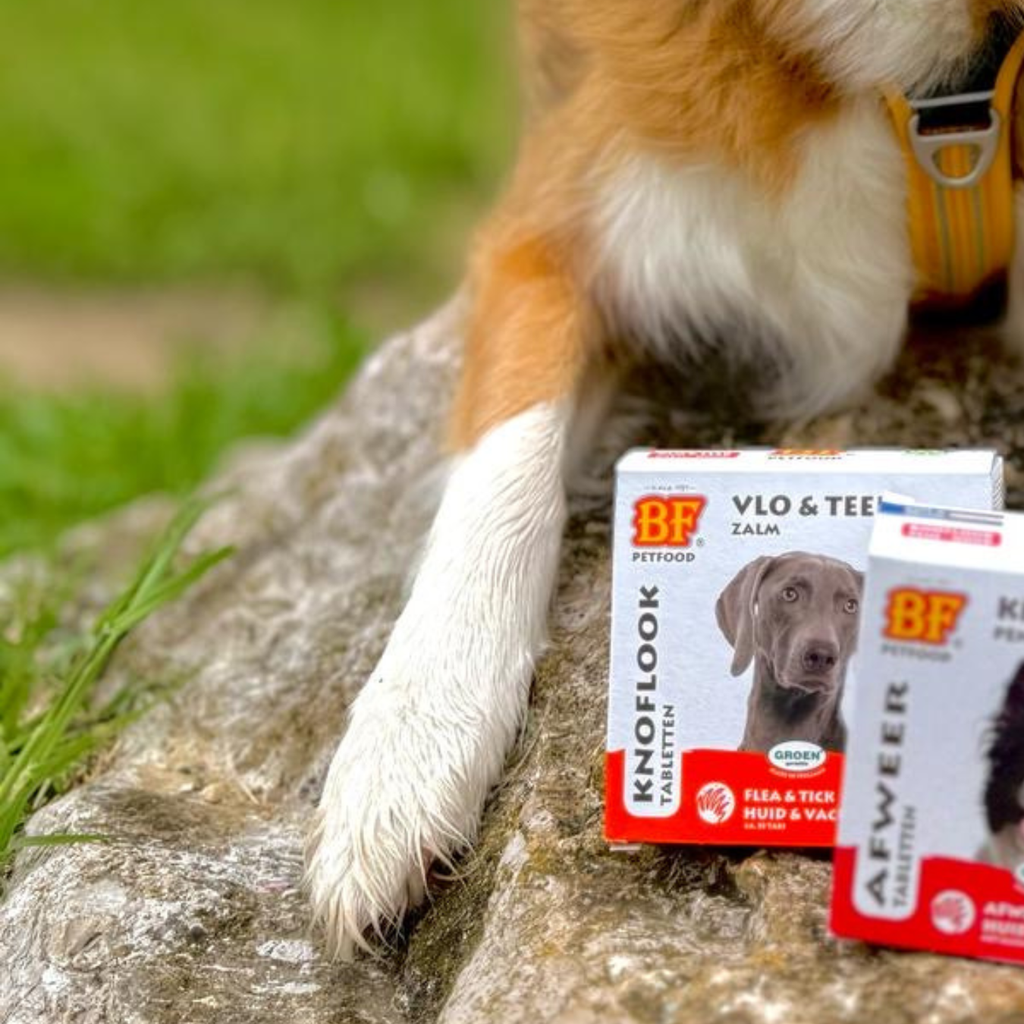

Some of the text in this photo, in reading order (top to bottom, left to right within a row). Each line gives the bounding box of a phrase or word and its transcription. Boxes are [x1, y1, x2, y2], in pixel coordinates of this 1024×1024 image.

[632, 494, 707, 547] BF
[732, 495, 791, 517] VLO
[798, 495, 819, 517] &
[825, 495, 882, 517] TEE
[731, 522, 781, 536] ZALM
[632, 552, 696, 563] PETFOOD
[880, 584, 968, 647] BF
[632, 584, 660, 803] KNOFLOOK
[659, 704, 676, 807] TABLETTEN
[774, 750, 820, 760] GROEN
[744, 789, 836, 804] FLEA & TICK
[864, 680, 909, 908] AFWEER
[743, 807, 787, 821] HUID
[789, 807, 802, 822] &
[891, 804, 918, 908] TABLETTEN
